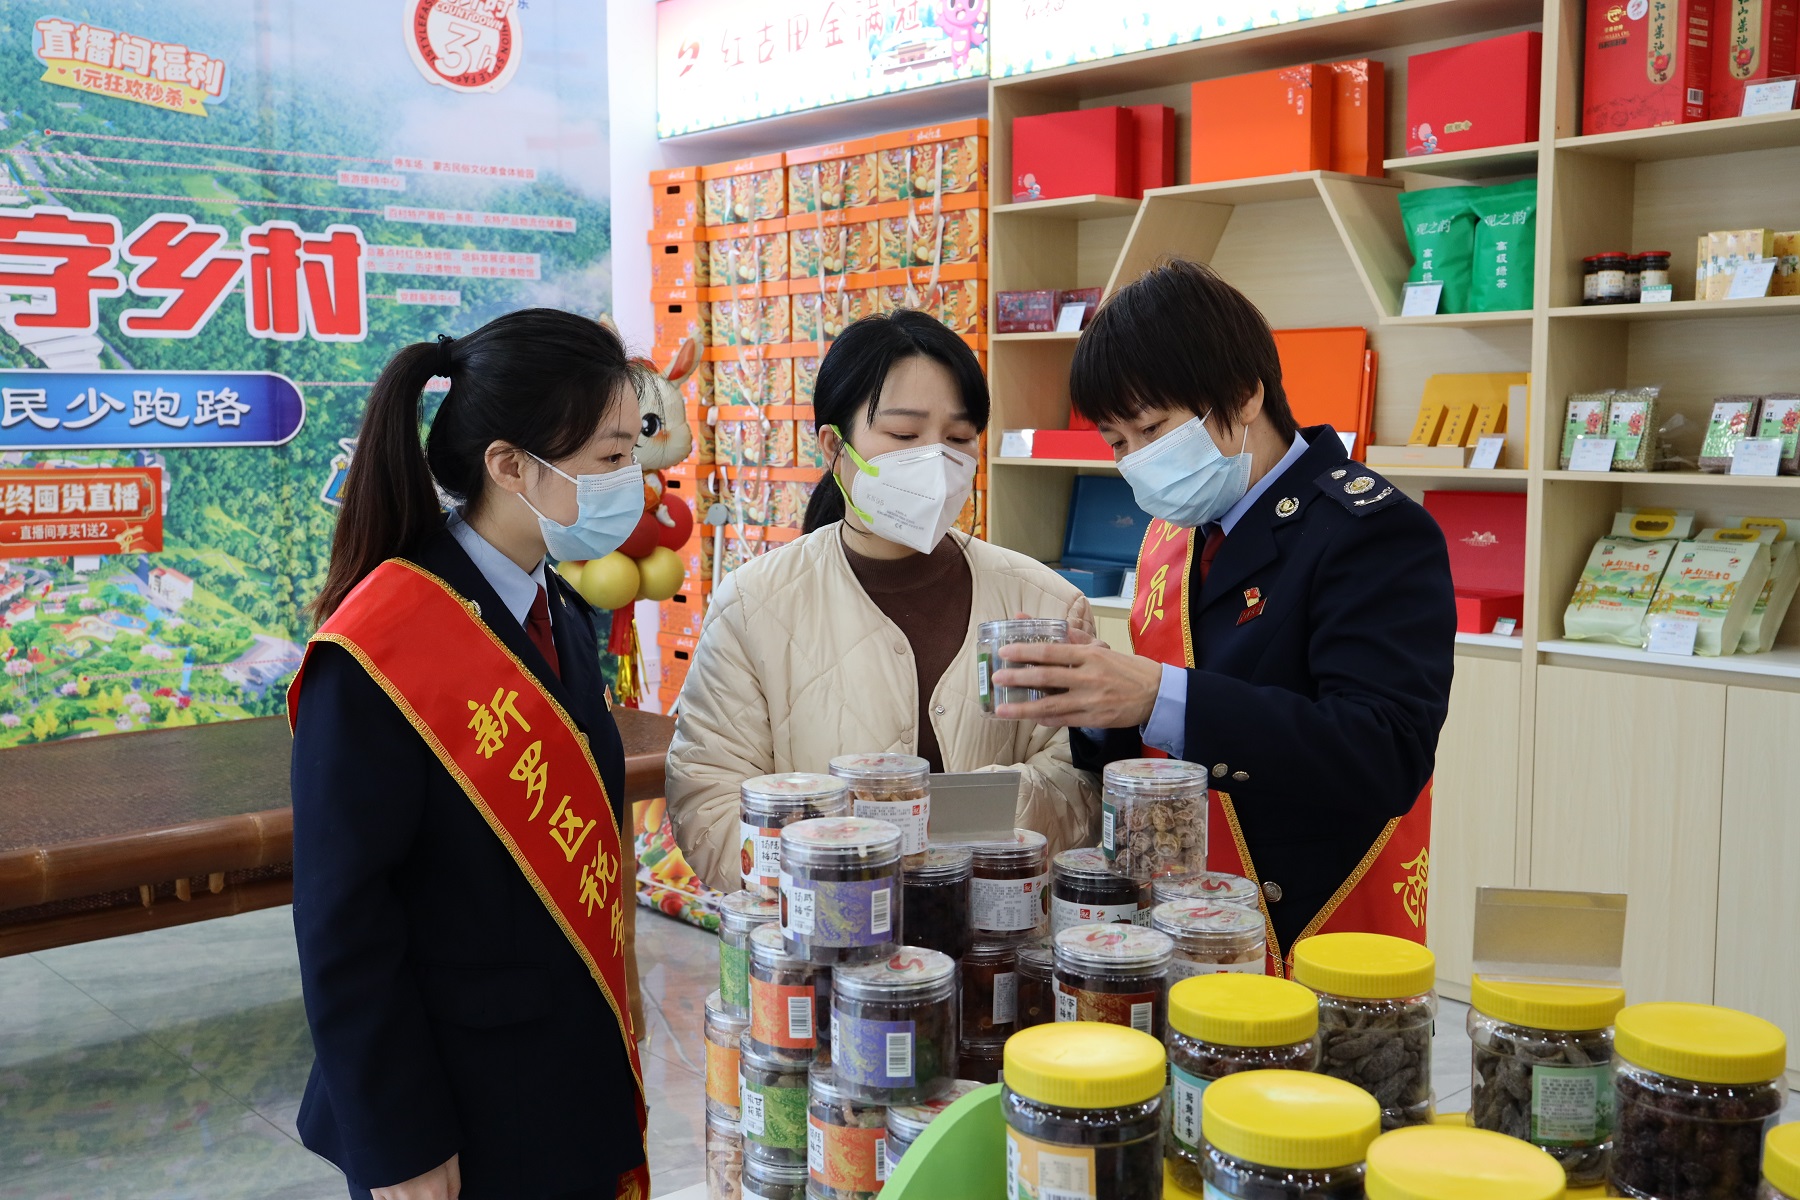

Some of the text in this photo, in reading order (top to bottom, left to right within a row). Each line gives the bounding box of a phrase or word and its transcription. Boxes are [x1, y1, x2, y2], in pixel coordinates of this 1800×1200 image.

[435, 2, 504, 30] COUNTDOWN
[36, 18, 226, 97] 直播间福利
[434, 21, 498, 77] 3h
[72, 68, 185, 107] 1元狂欢秒杀
[1, 386, 251, 429] 民少跑路
[0, 482, 140, 515] 终囤货直播
[20, 522, 109, 541] 直播间享买1送2
